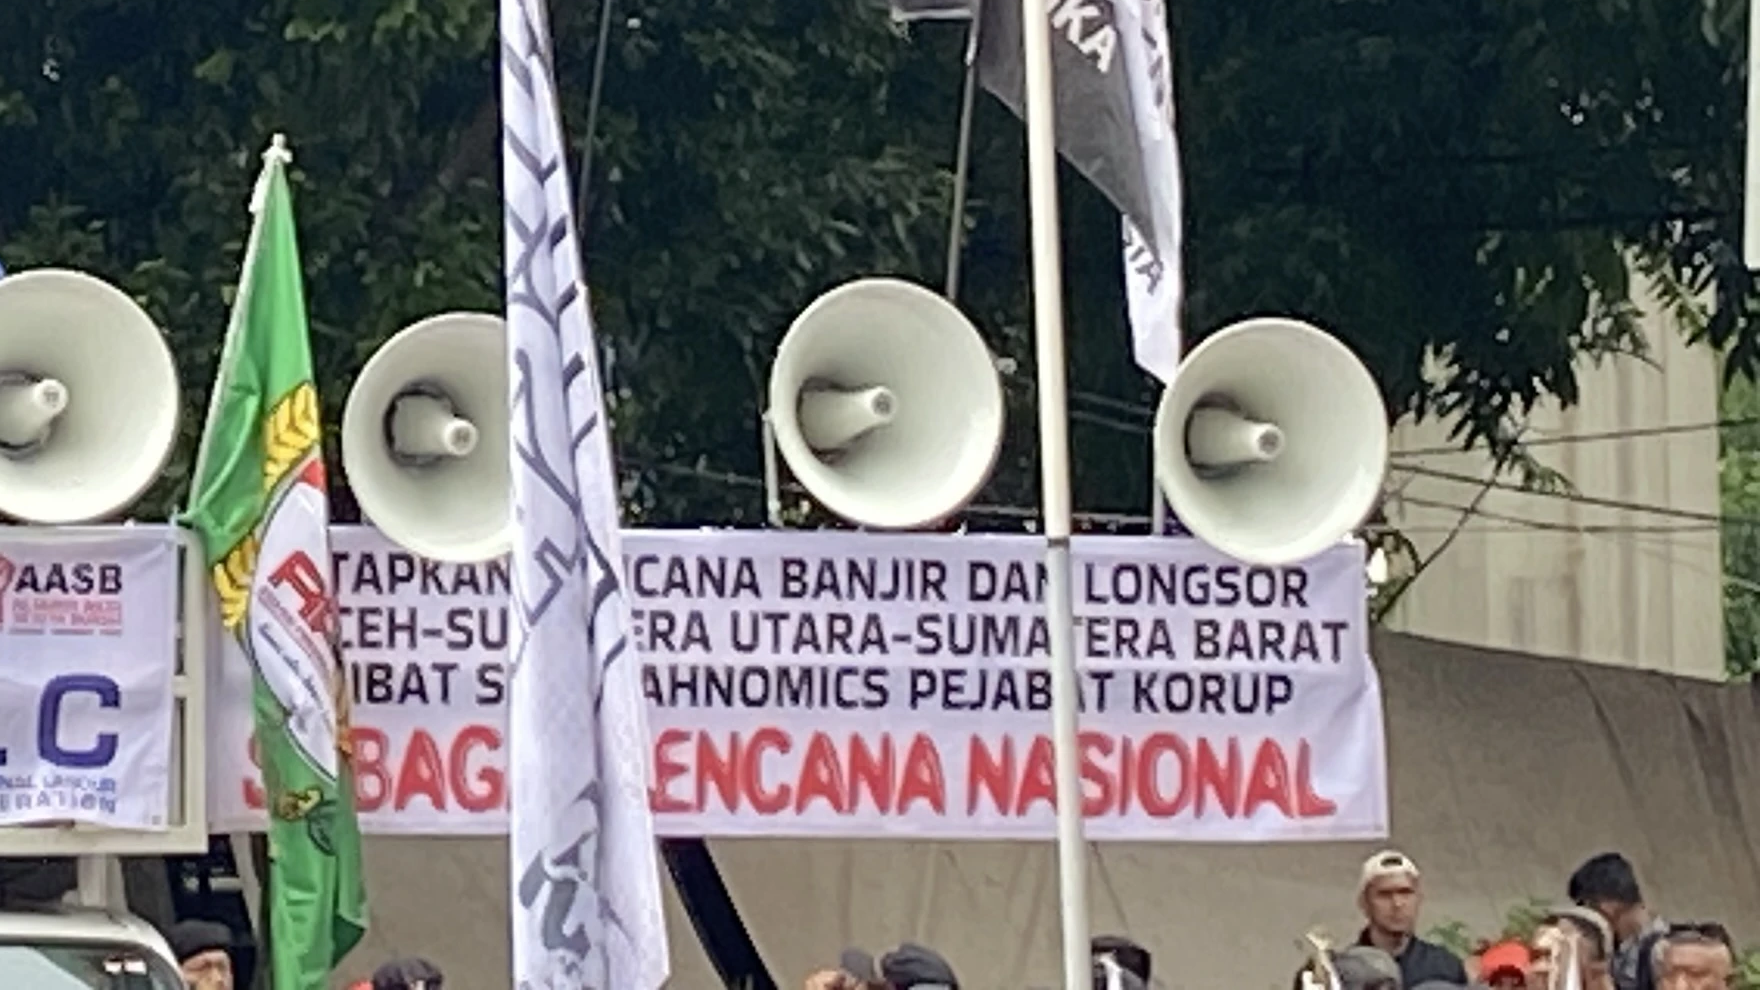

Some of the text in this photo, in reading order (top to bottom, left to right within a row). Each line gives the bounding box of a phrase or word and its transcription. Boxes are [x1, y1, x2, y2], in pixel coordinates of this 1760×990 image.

[14, 563, 123, 595] AASB
[331, 551, 511, 596] TAPKAN
[780, 557, 947, 602] BANJIR
[1084, 561, 1309, 607] LONGSOR
[730, 609, 1177, 662] UTARA-SUMAERA
[1194, 619, 1349, 663] BARAT
[350, 661, 459, 706] IBAT
[1137, 670, 1294, 715] KORUP
[647, 726, 946, 818] ENCANA
